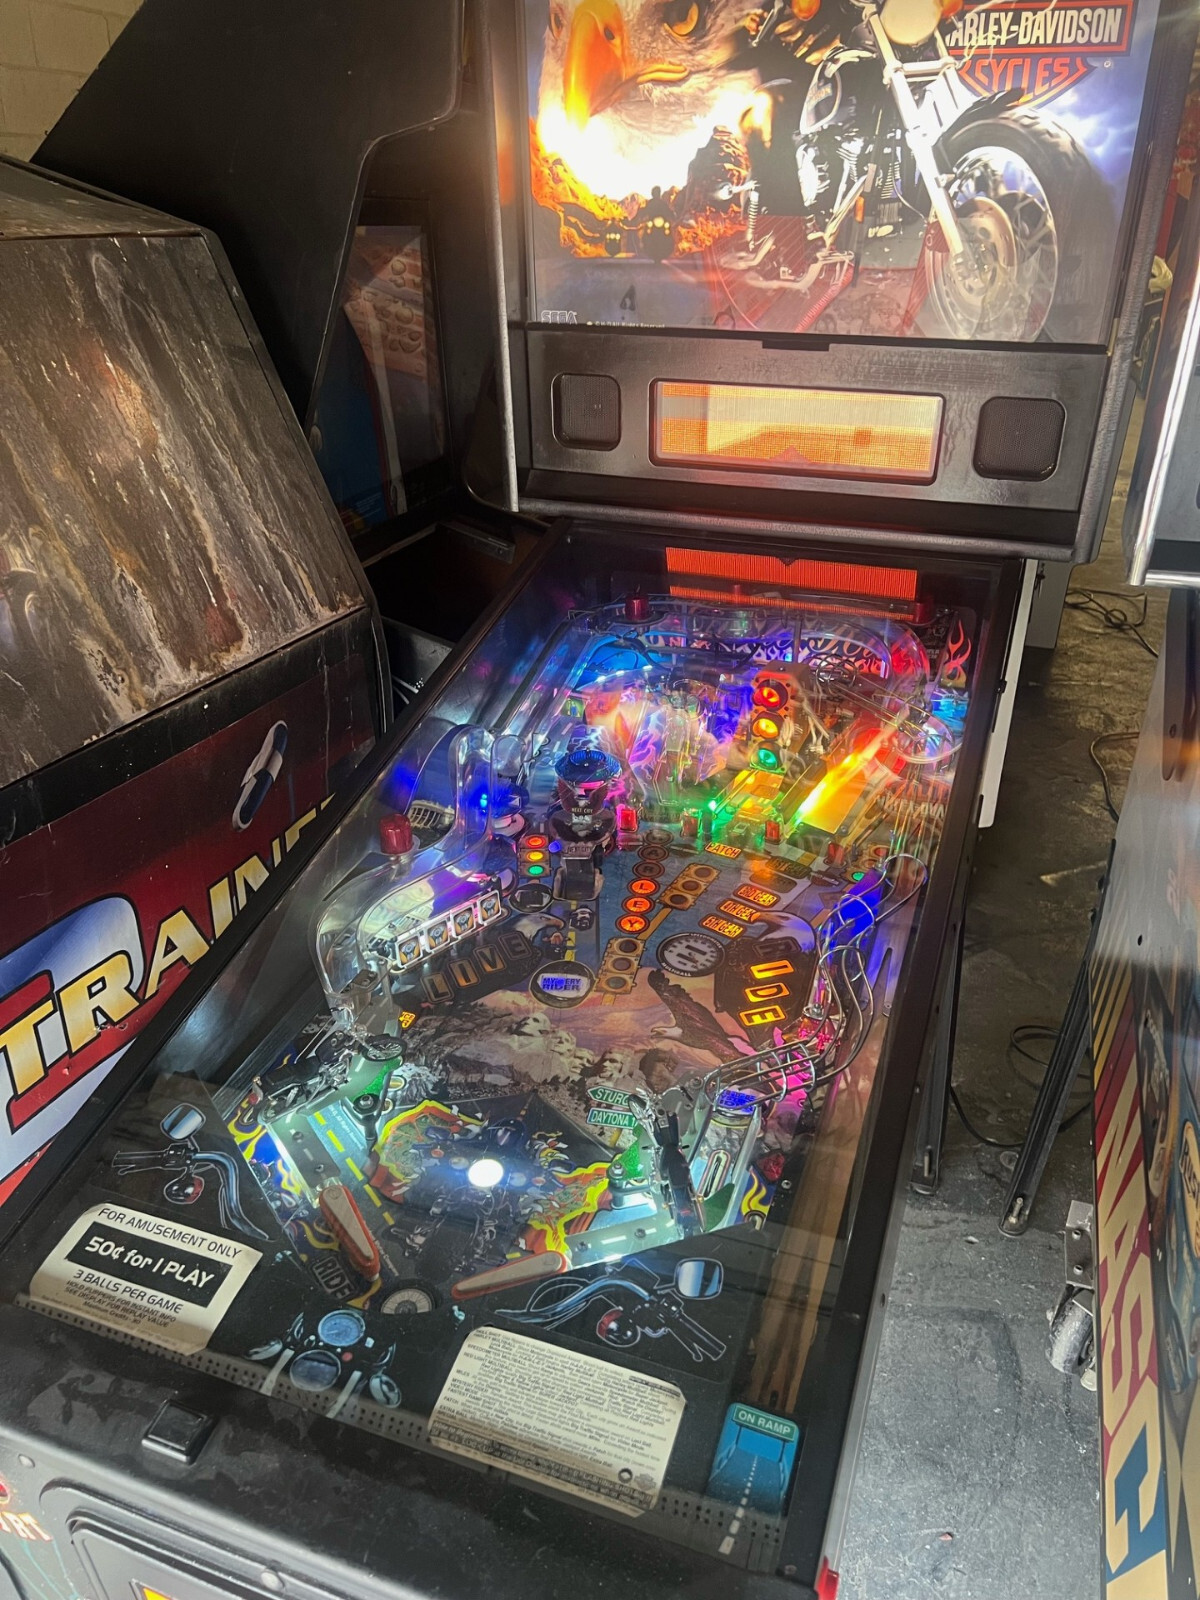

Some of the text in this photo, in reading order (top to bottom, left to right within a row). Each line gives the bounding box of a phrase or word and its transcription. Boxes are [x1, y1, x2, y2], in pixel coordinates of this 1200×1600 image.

[541, 310, 577, 324] SEGA
[706, 842, 740, 858] PATCH
[753, 890, 778, 906] GEAR
[718, 922, 744, 938] GEAR
[590, 1112, 629, 1125] DAYTONA
[98, 1208, 243, 1259] FOR AMUSEMENT ONLY
[85, 1236, 125, 1260] 50¢
[123, 1248, 151, 1269] for
[162, 1260, 215, 1289] PLAY
[66, 1280, 176, 1322] HOLD FLIPPERS FOR INSTANT INFO
[73, 1269, 183, 1314] 3 BALLS PER GAME
[64, 1286, 170, 1328] SEE DISPLAY FOR REPLAY VALUE
[738, 1411, 791, 1435] ON RAMP
